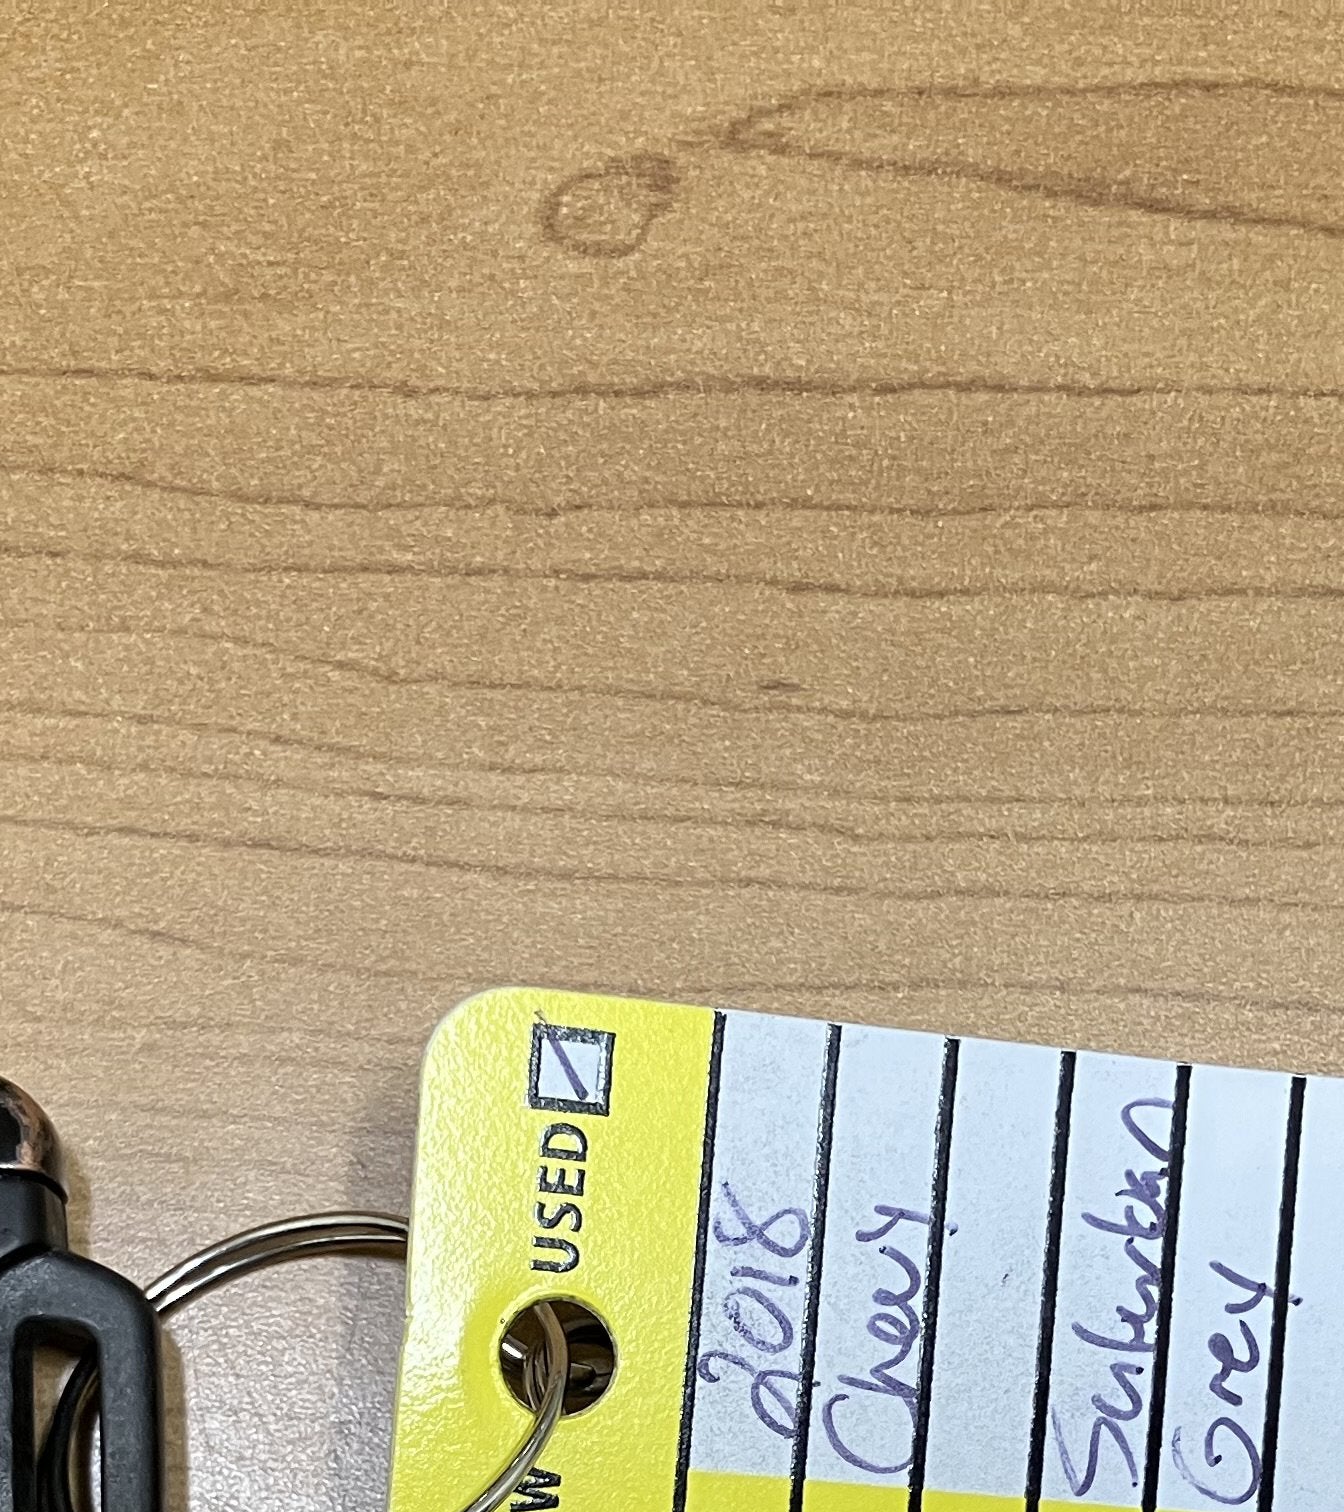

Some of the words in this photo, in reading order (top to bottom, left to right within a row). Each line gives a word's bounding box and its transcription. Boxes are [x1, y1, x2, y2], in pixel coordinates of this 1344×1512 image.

[529, 1121, 588, 1274] USED
[697, 1181, 816, 1440] 2018
[822, 1204, 958, 1475] Chevy
[1171, 1260, 1304, 1505] Grey
